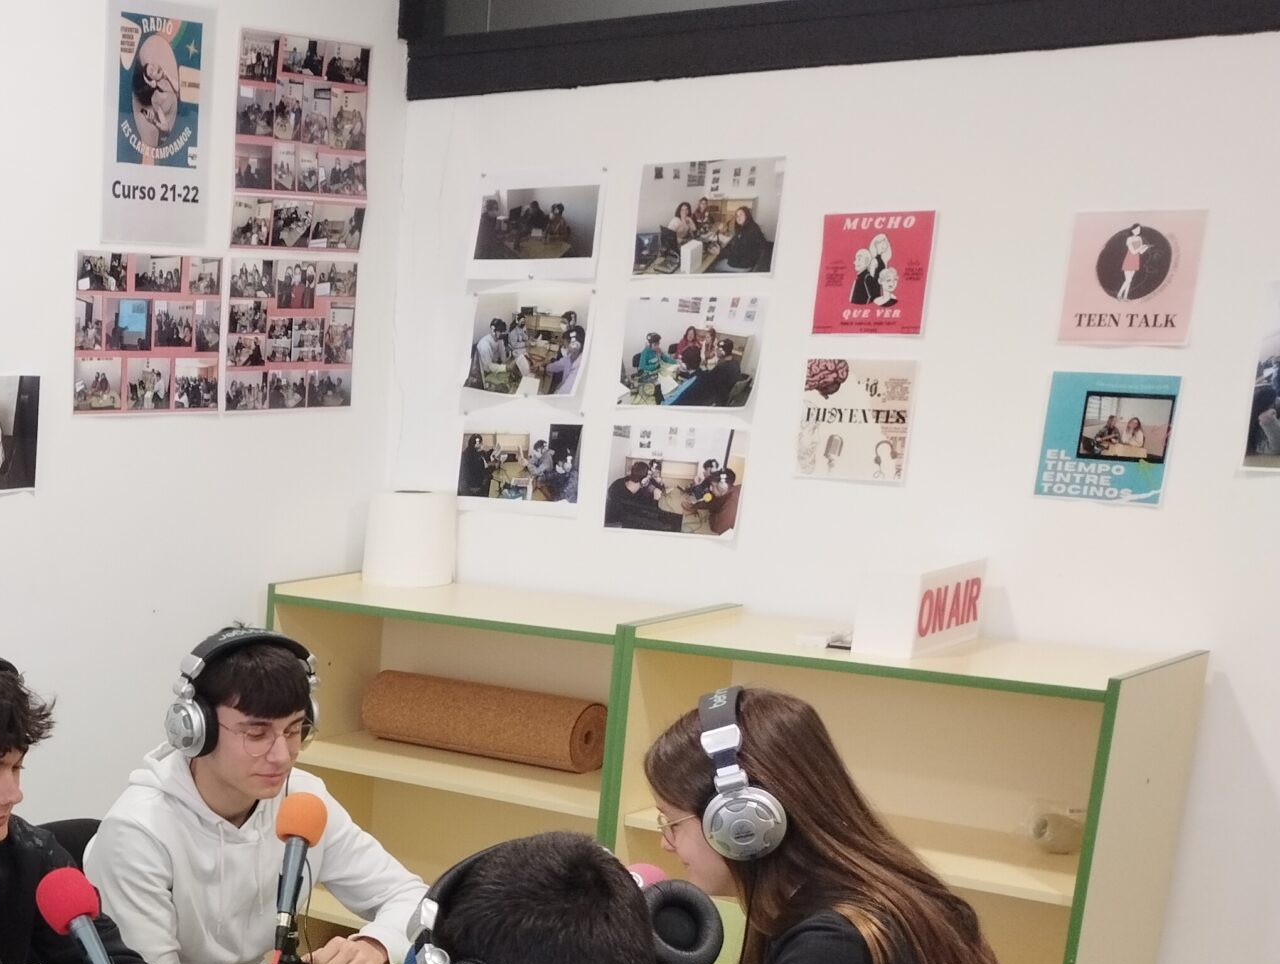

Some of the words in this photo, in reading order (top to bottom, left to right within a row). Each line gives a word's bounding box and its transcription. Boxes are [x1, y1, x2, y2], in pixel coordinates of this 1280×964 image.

[142, 17, 173, 35] RADIO
[121, 120, 132, 138] IES
[130, 133, 151, 158] CLARA
[151, 126, 192, 160] CAMPOAMOR
[112, 180, 156, 201] Curso
[160, 184, 200, 204] 21-22
[843, 216, 916, 230] MUCHO
[842, 309, 869, 320] QUE
[876, 309, 901, 318] VER
[1075, 313, 1121, 328] TEEN
[1126, 313, 1177, 328] TALK
[1046, 448, 1071, 460] EL
[1045, 460, 1125, 475] TIEMPO
[1042, 471, 1112, 486] ENTRE
[1041, 482, 1132, 499] TOCINOS
[918, 585, 949, 637] ON
[946, 577, 981, 629] AIR
